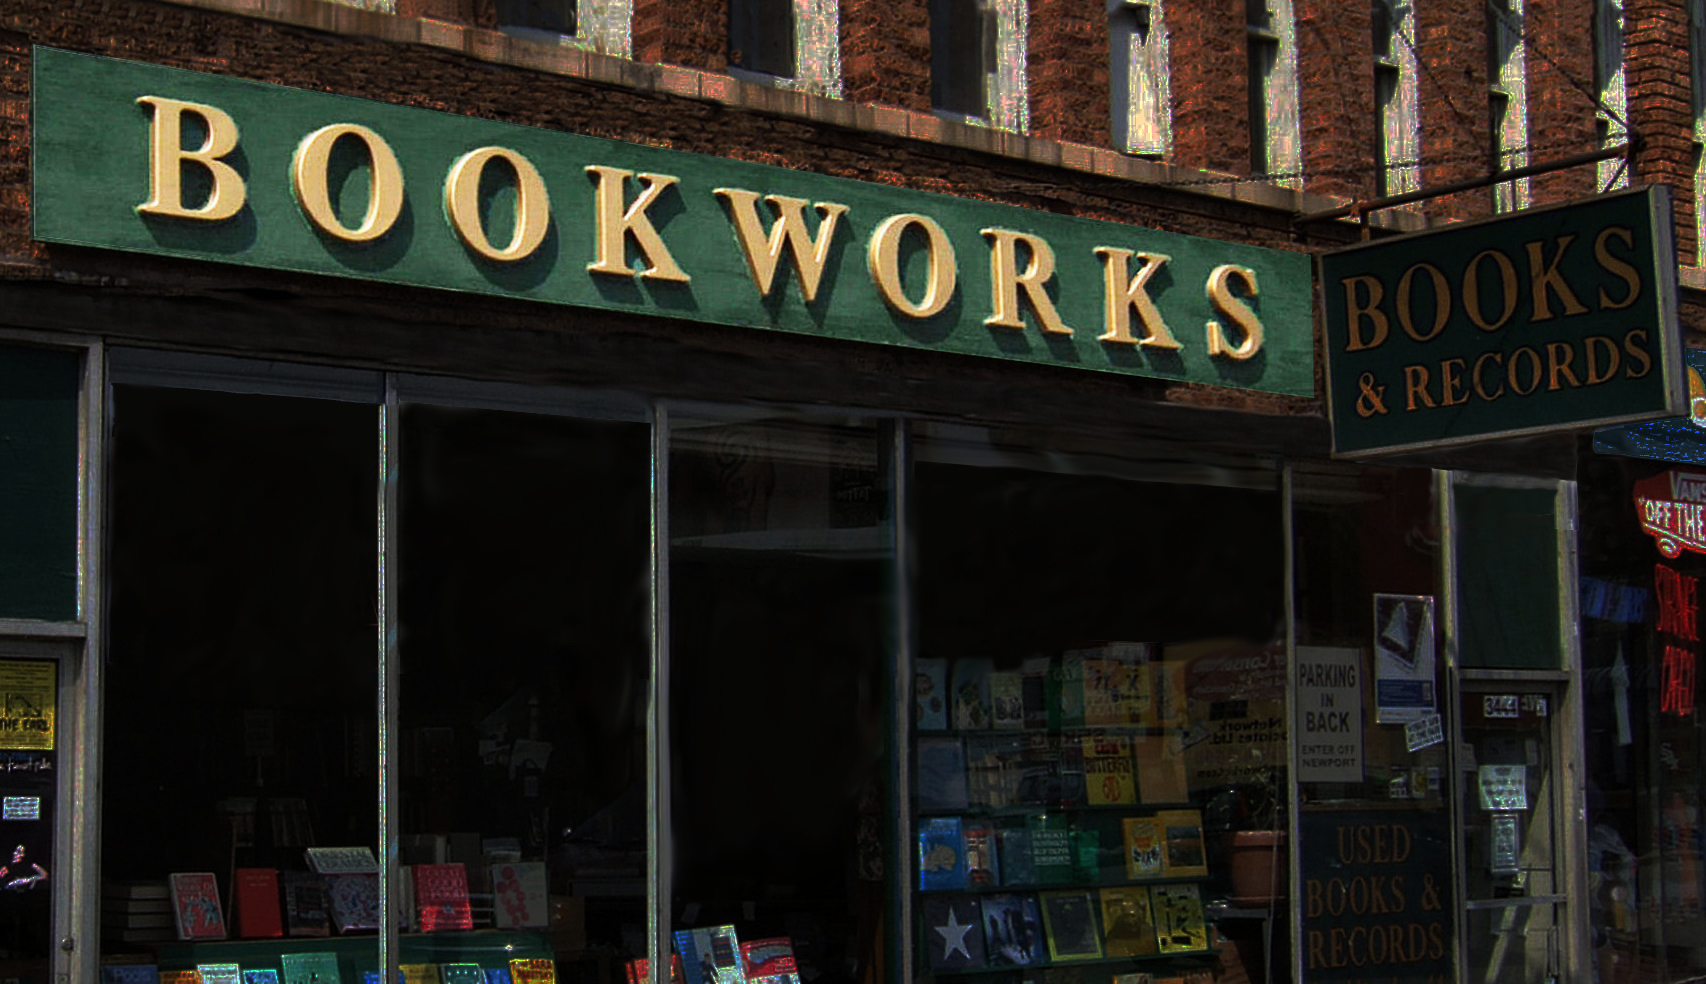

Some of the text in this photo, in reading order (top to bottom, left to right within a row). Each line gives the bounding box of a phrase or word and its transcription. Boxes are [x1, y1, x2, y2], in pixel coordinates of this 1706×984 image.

[135, 94, 1265, 362] BOOKWORKS
[1340, 225, 1643, 353] BOOKS
[1355, 328, 1654, 419] & RECORDS
[1673, 502, 1706, 541] THE
[1299, 663, 1357, 689] PARKING
[1320, 693, 1334, 708] IN
[1305, 711, 1351, 734] BACK
[1302, 744, 1355, 755] ENTER OFF
[1302, 757, 1357, 768] NEWPORT
[1337, 824, 1412, 865] USED
[1305, 872, 1442, 918] BOOKS &
[1307, 921, 1445, 970] RECORDS
